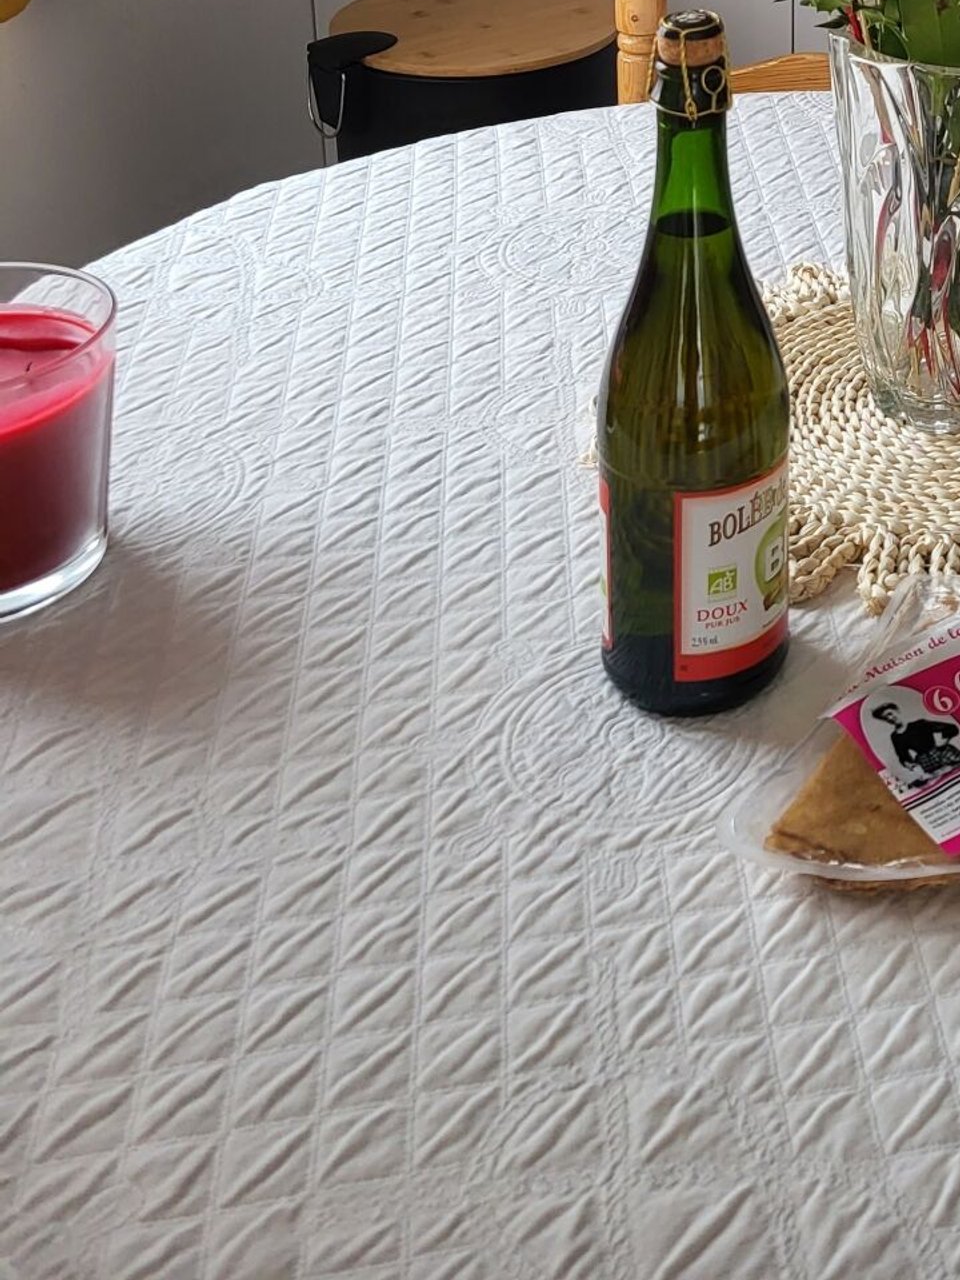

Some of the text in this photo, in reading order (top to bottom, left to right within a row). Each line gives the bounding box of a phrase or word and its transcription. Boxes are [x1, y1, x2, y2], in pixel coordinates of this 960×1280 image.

[696, 600, 748, 623] DOUX
[864, 646, 924, 683] Maison
[927, 636, 946, 650] de
[933, 688, 953, 712] 6
